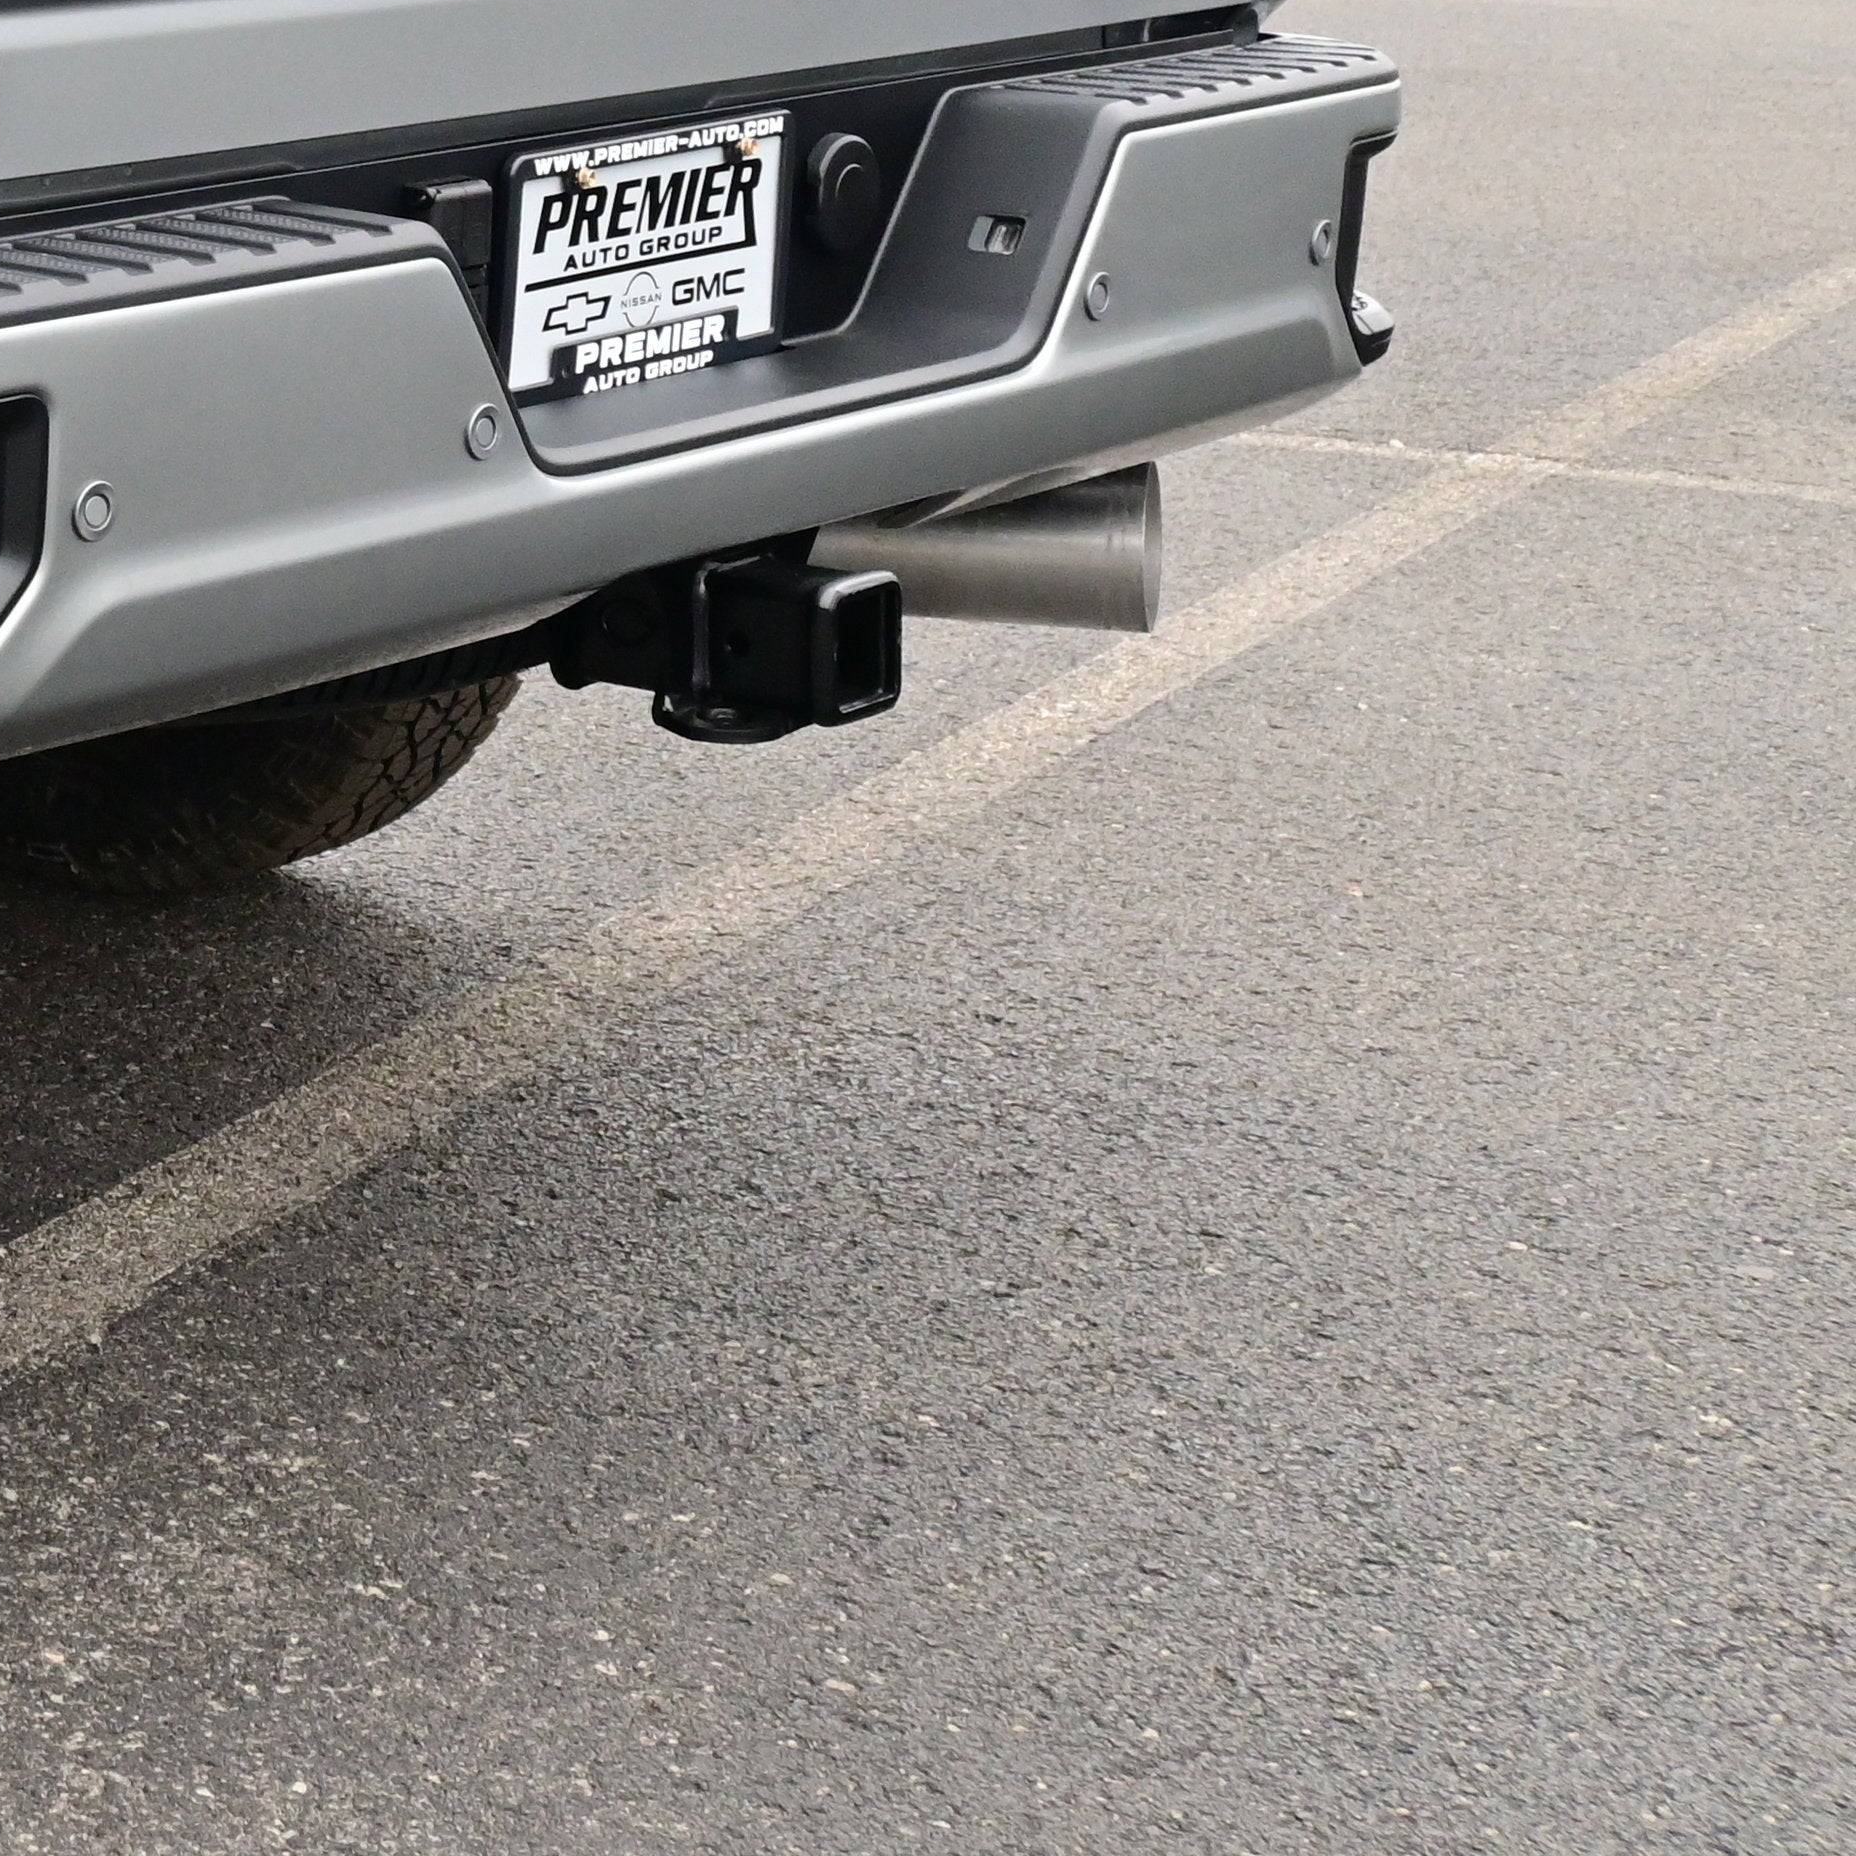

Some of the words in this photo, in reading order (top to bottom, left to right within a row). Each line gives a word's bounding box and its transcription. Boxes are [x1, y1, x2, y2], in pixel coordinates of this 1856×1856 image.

[534, 116, 784, 176] WWW.PREMIER-AUTO.COM
[533, 158, 762, 255] PREMIER
[563, 245, 630, 272] AUTO
[639, 226, 723, 256] GROUP
[620, 292, 662, 309] NISSAN
[672, 268, 745, 306] GMC
[575, 314, 725, 375] PREMIER
[583, 365, 641, 394] AUTO
[644, 350, 714, 379] GROUP
